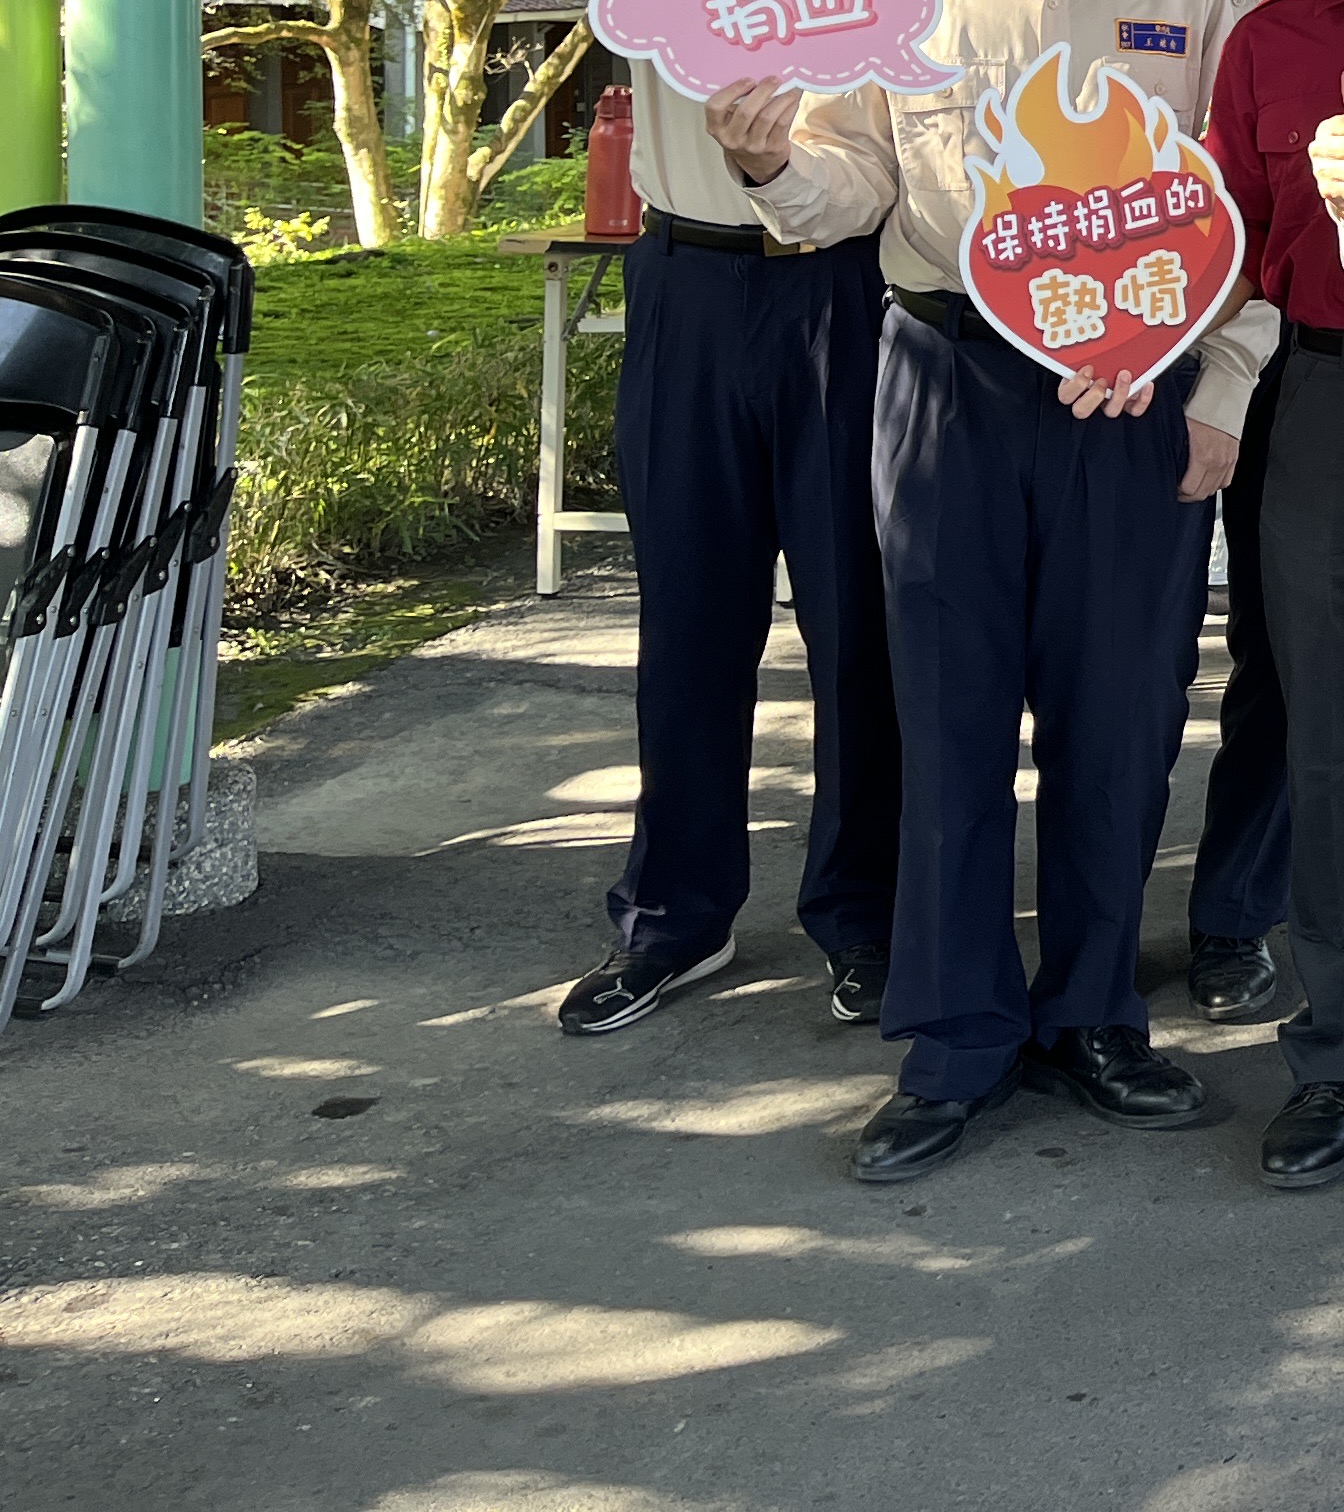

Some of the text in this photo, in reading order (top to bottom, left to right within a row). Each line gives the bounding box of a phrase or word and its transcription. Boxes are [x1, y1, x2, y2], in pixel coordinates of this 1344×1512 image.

[981, 178, 1205, 263] 保持捐血的
[1029, 251, 1188, 349] 熱情
